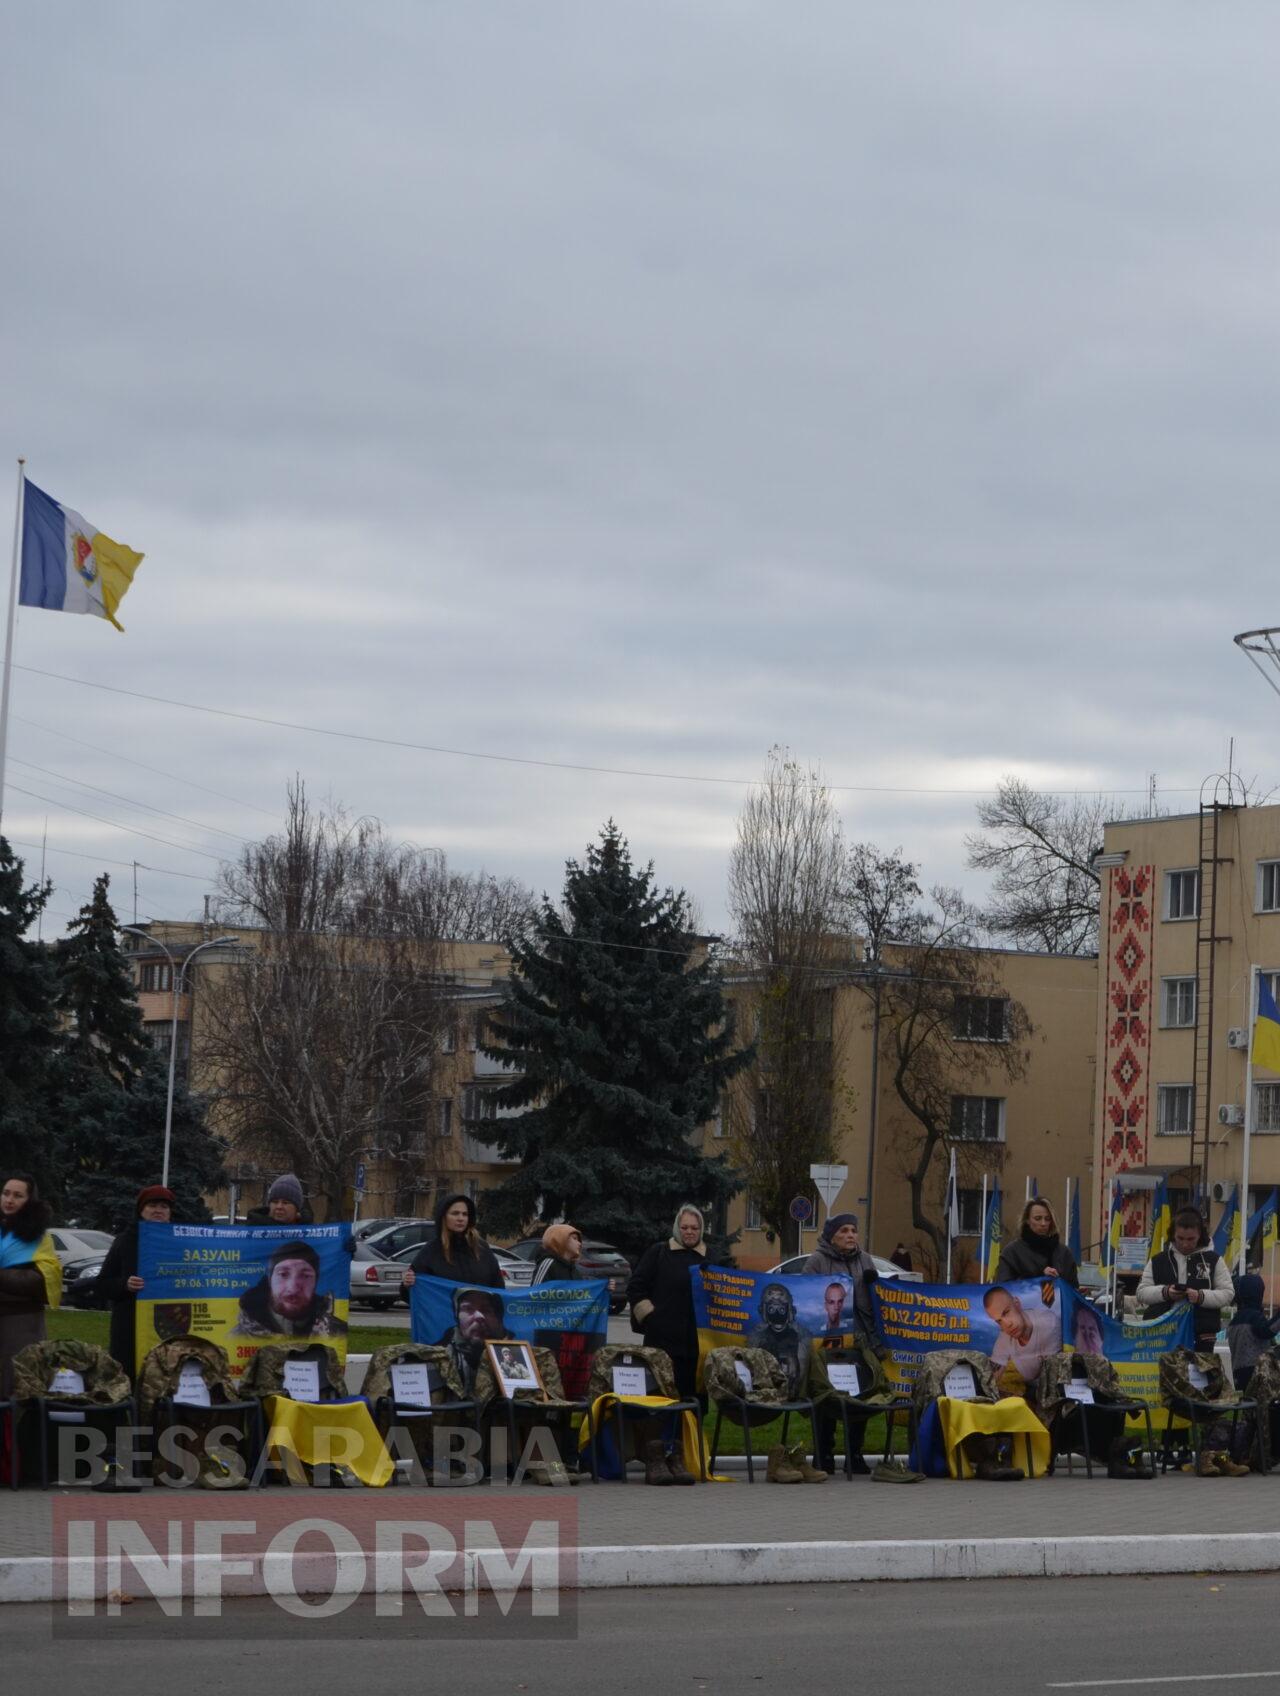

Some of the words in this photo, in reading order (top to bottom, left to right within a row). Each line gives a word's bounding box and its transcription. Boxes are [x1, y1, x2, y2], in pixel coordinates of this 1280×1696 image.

[183, 1249, 241, 1262] ЗАЗУЛІН
[193, 1303, 208, 1313] 118
[915, 1293, 970, 1311] Радомир
[880, 1306, 947, 1328] 30.12.2005
[236, 1346, 258, 1359] ЗНИ
